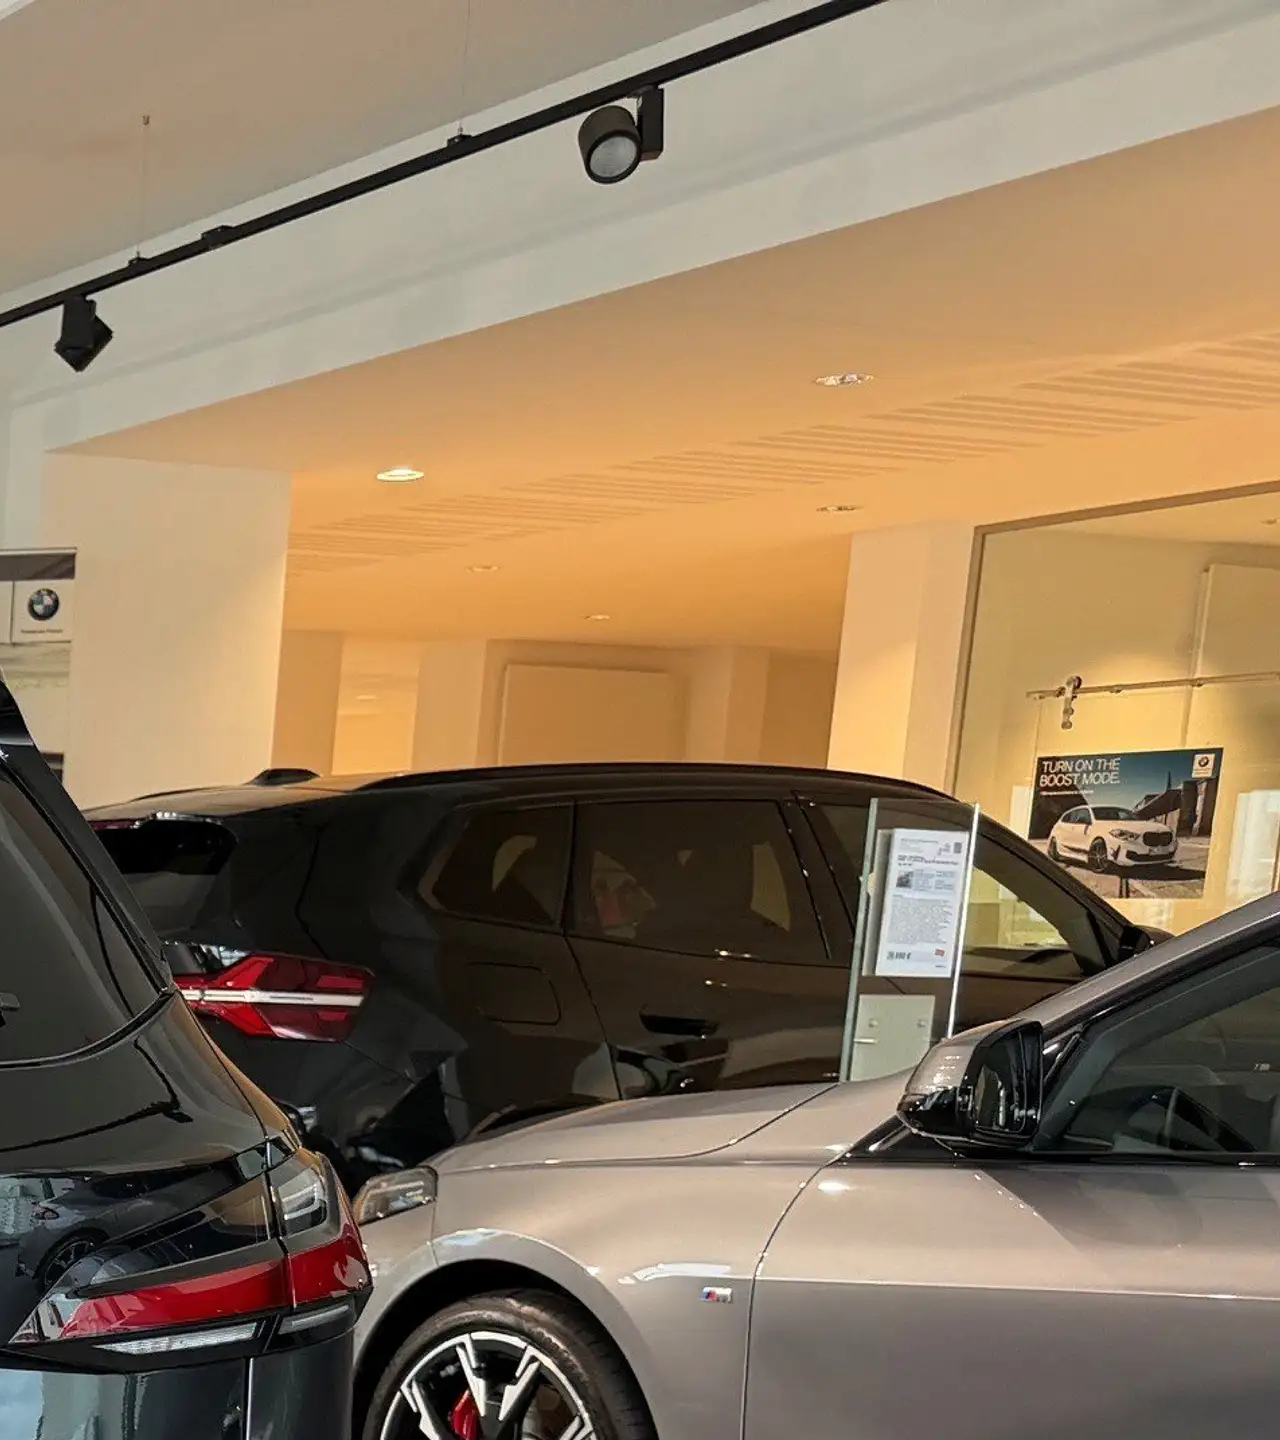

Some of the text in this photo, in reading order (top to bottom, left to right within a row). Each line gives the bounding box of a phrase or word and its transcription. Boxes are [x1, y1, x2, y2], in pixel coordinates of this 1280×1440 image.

[1042, 757, 1121, 774] TURN ON THE
[1040, 773, 1080, 787] BOOST
